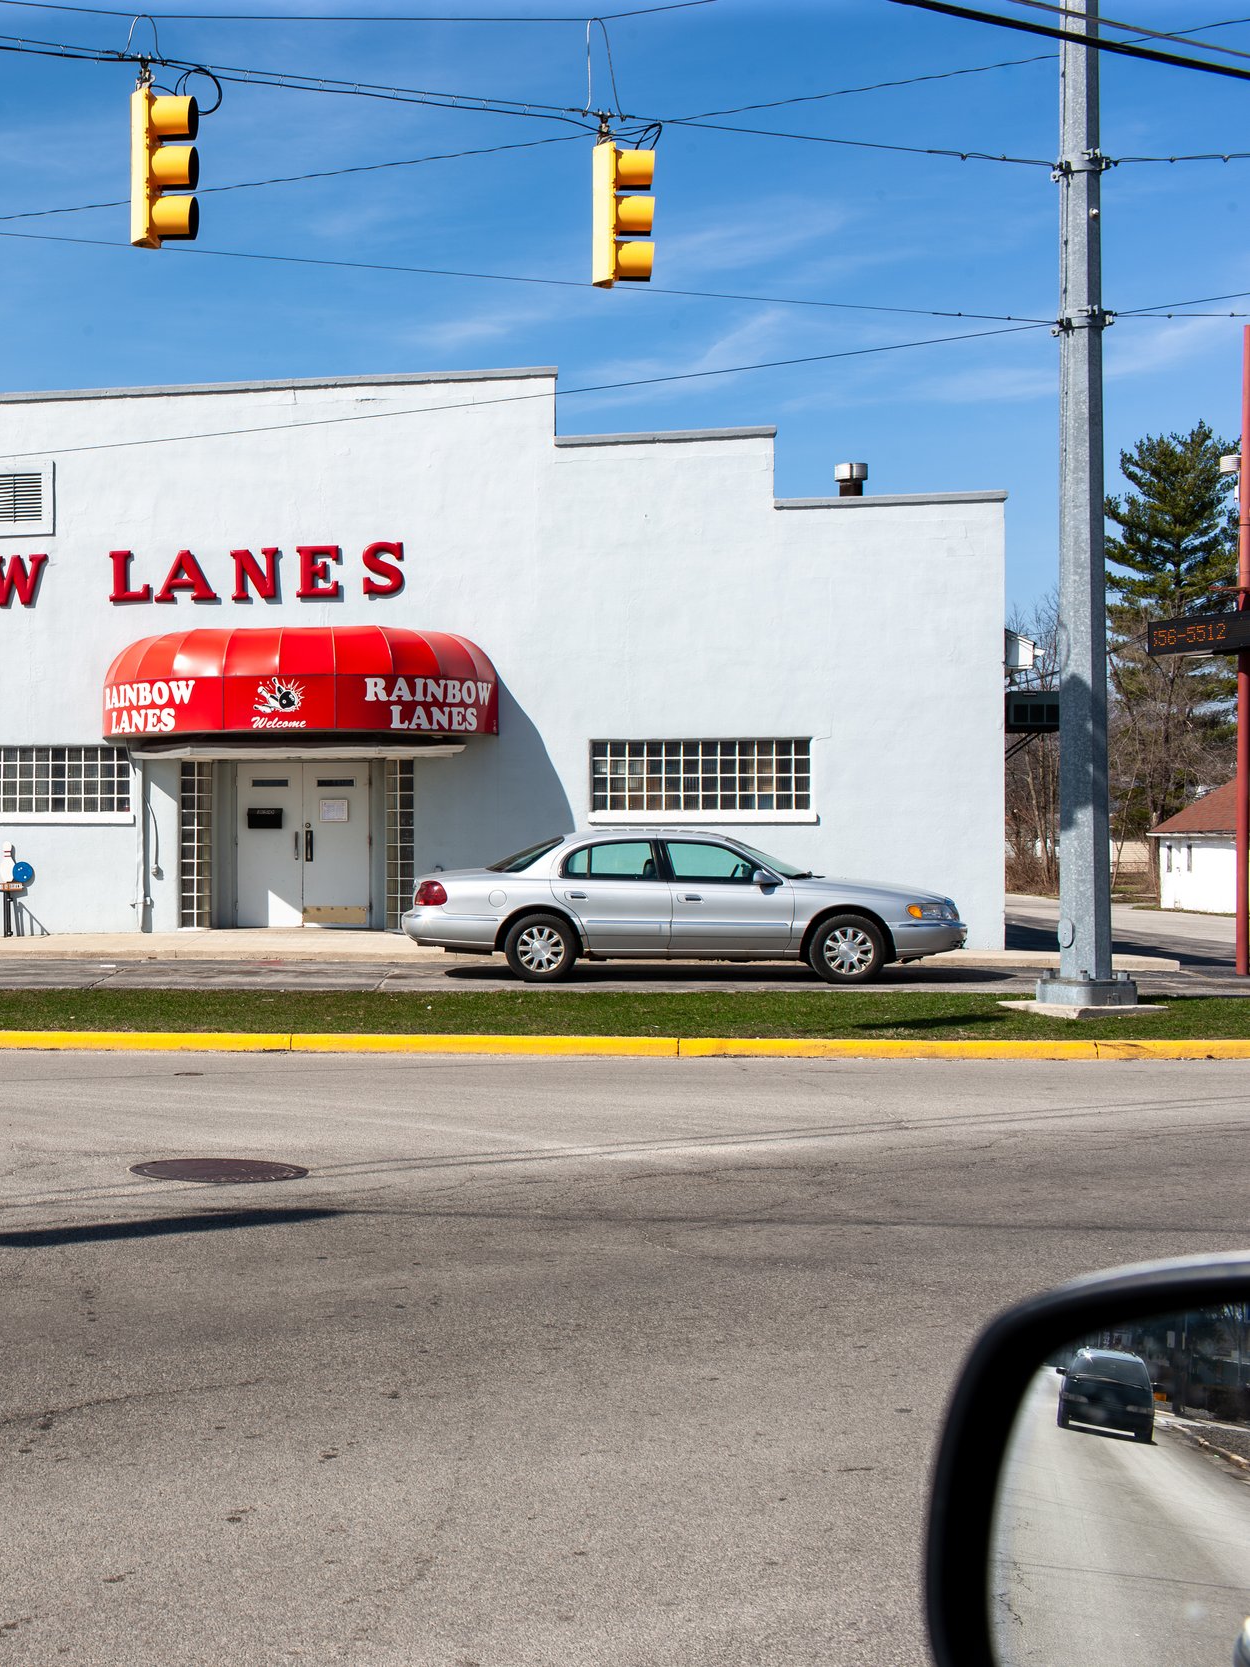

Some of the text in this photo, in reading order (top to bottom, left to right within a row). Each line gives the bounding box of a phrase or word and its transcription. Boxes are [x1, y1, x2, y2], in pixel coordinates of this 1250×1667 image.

[109, 541, 405, 603] LANES
[105, 680, 196, 710] RAINBOW
[364, 677, 492, 706] RAINBOW
[111, 707, 176, 734] LANES
[251, 716, 307, 728] Welcome
[390, 705, 478, 731] LANES
